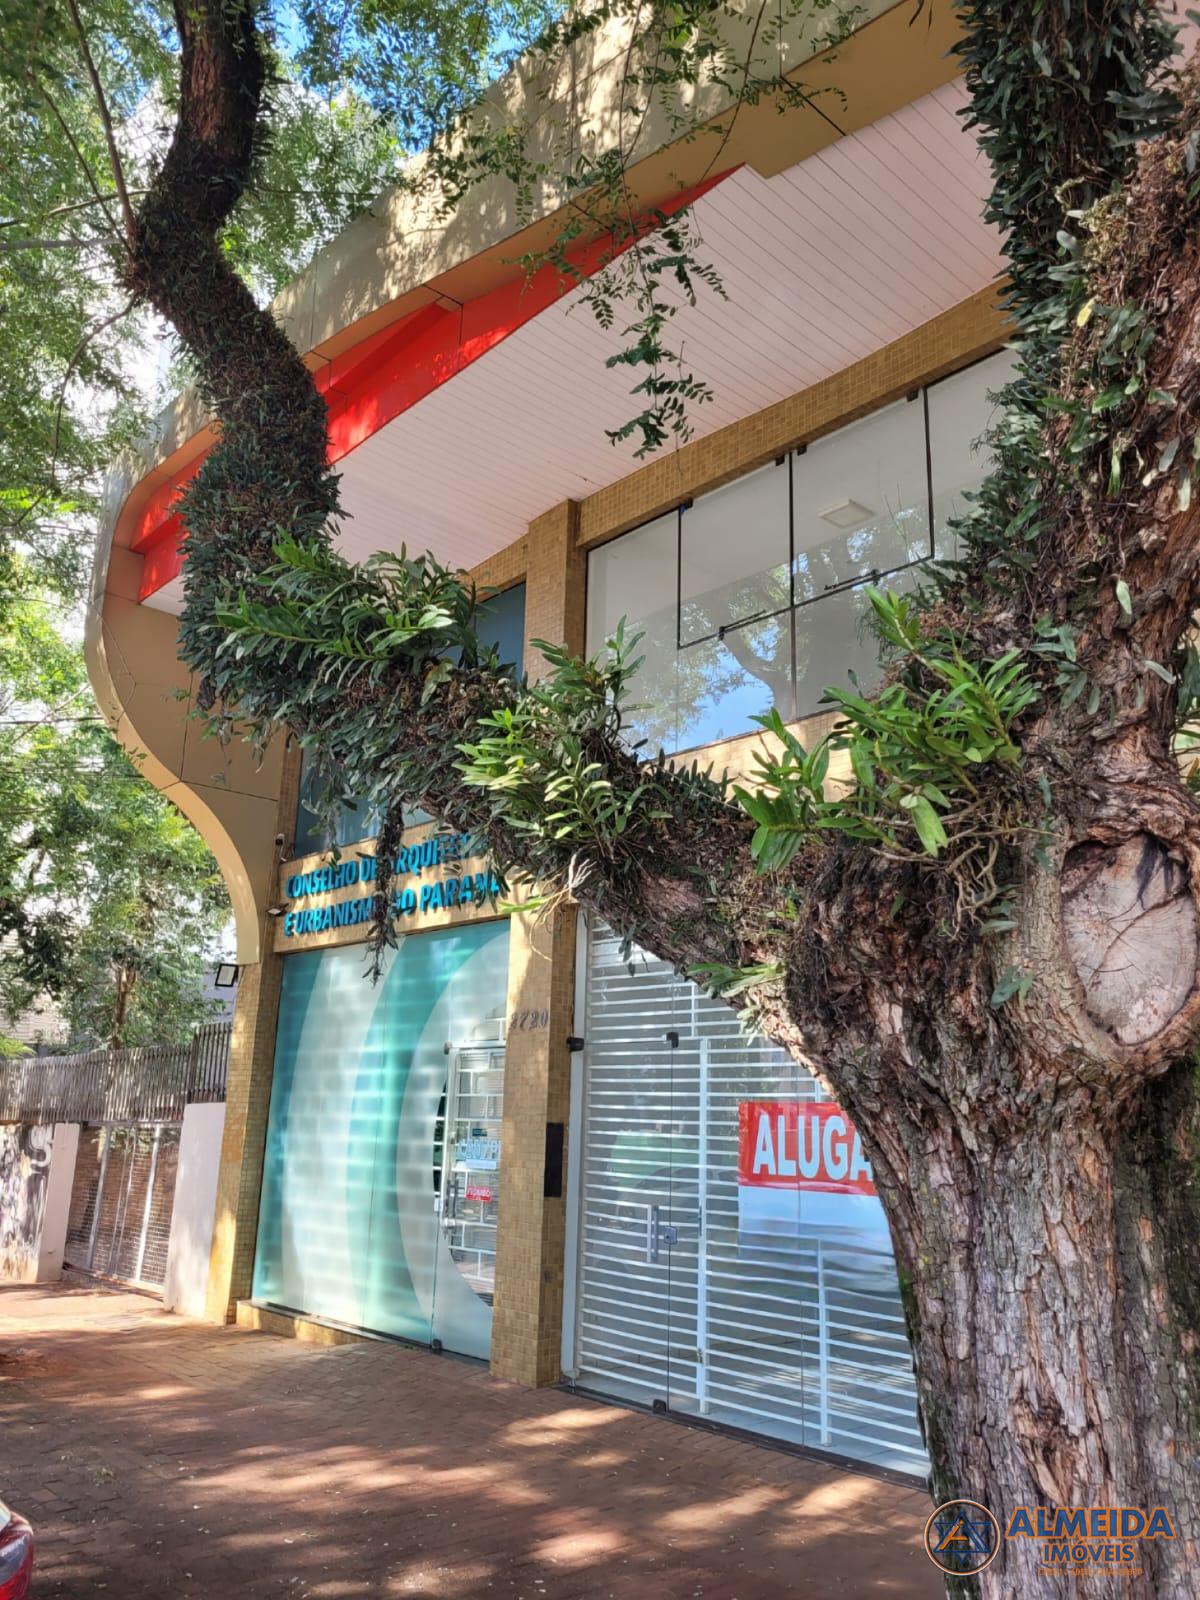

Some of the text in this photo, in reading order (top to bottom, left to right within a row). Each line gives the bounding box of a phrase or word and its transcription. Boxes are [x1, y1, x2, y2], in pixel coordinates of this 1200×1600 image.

[286, 861, 359, 899] CONSELHO
[284, 912, 294, 937] E
[295, 896, 376, 935] URBANISM
[752, 1114, 874, 1181] ALUGA
